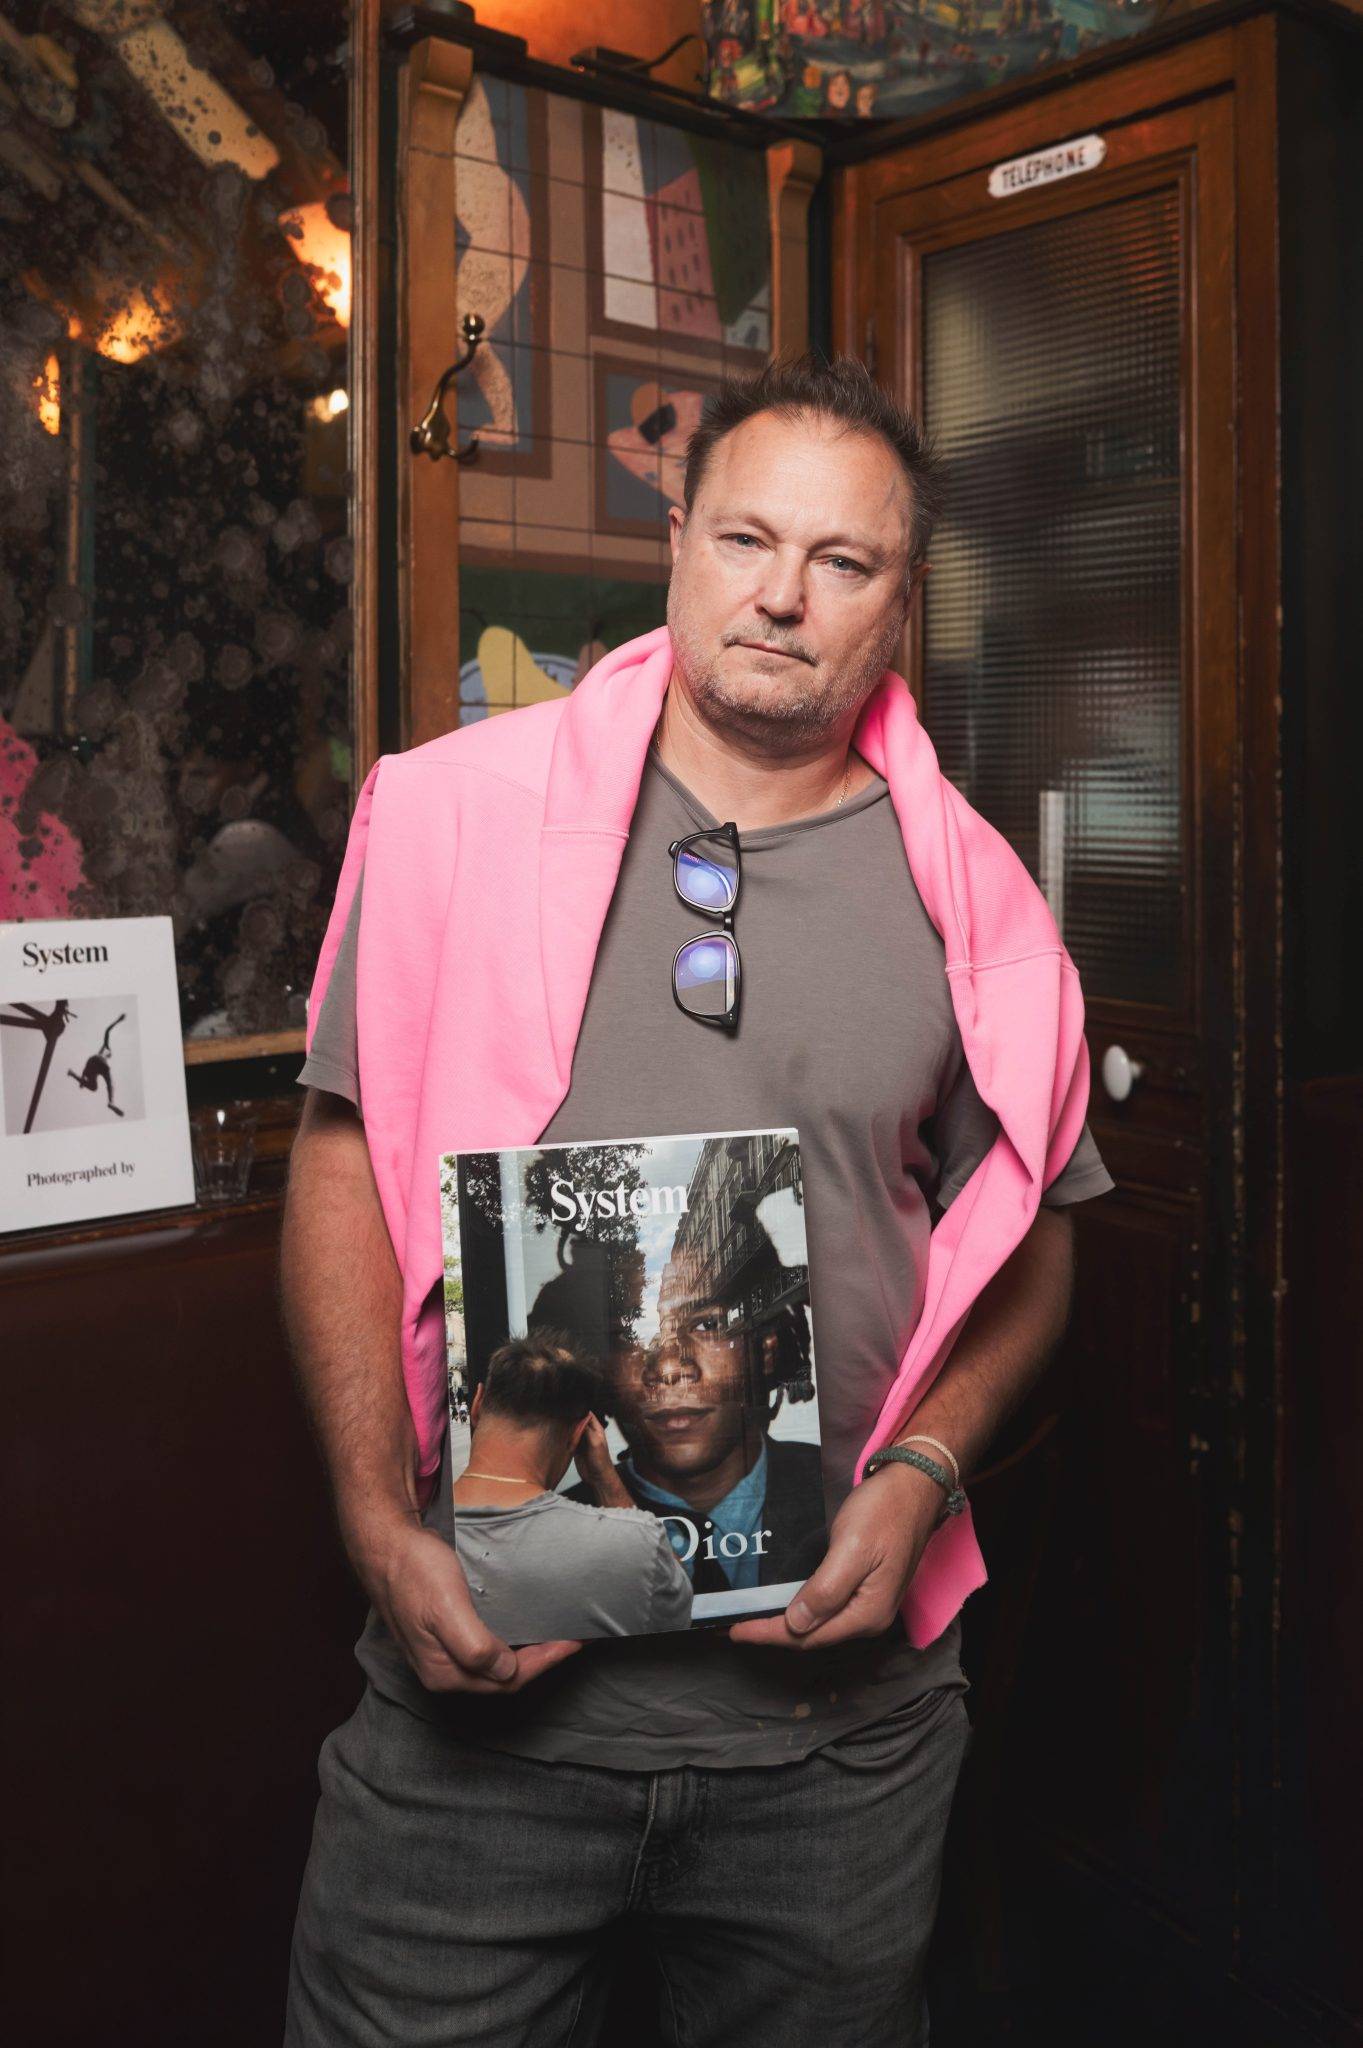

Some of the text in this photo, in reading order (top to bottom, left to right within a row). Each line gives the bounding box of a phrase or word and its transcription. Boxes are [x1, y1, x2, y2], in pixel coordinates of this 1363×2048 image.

[22, 941, 109, 974] System
[26, 1160, 136, 1188] Photographed by
[550, 1178, 690, 1232] System
[655, 1515, 773, 1562] Dior
